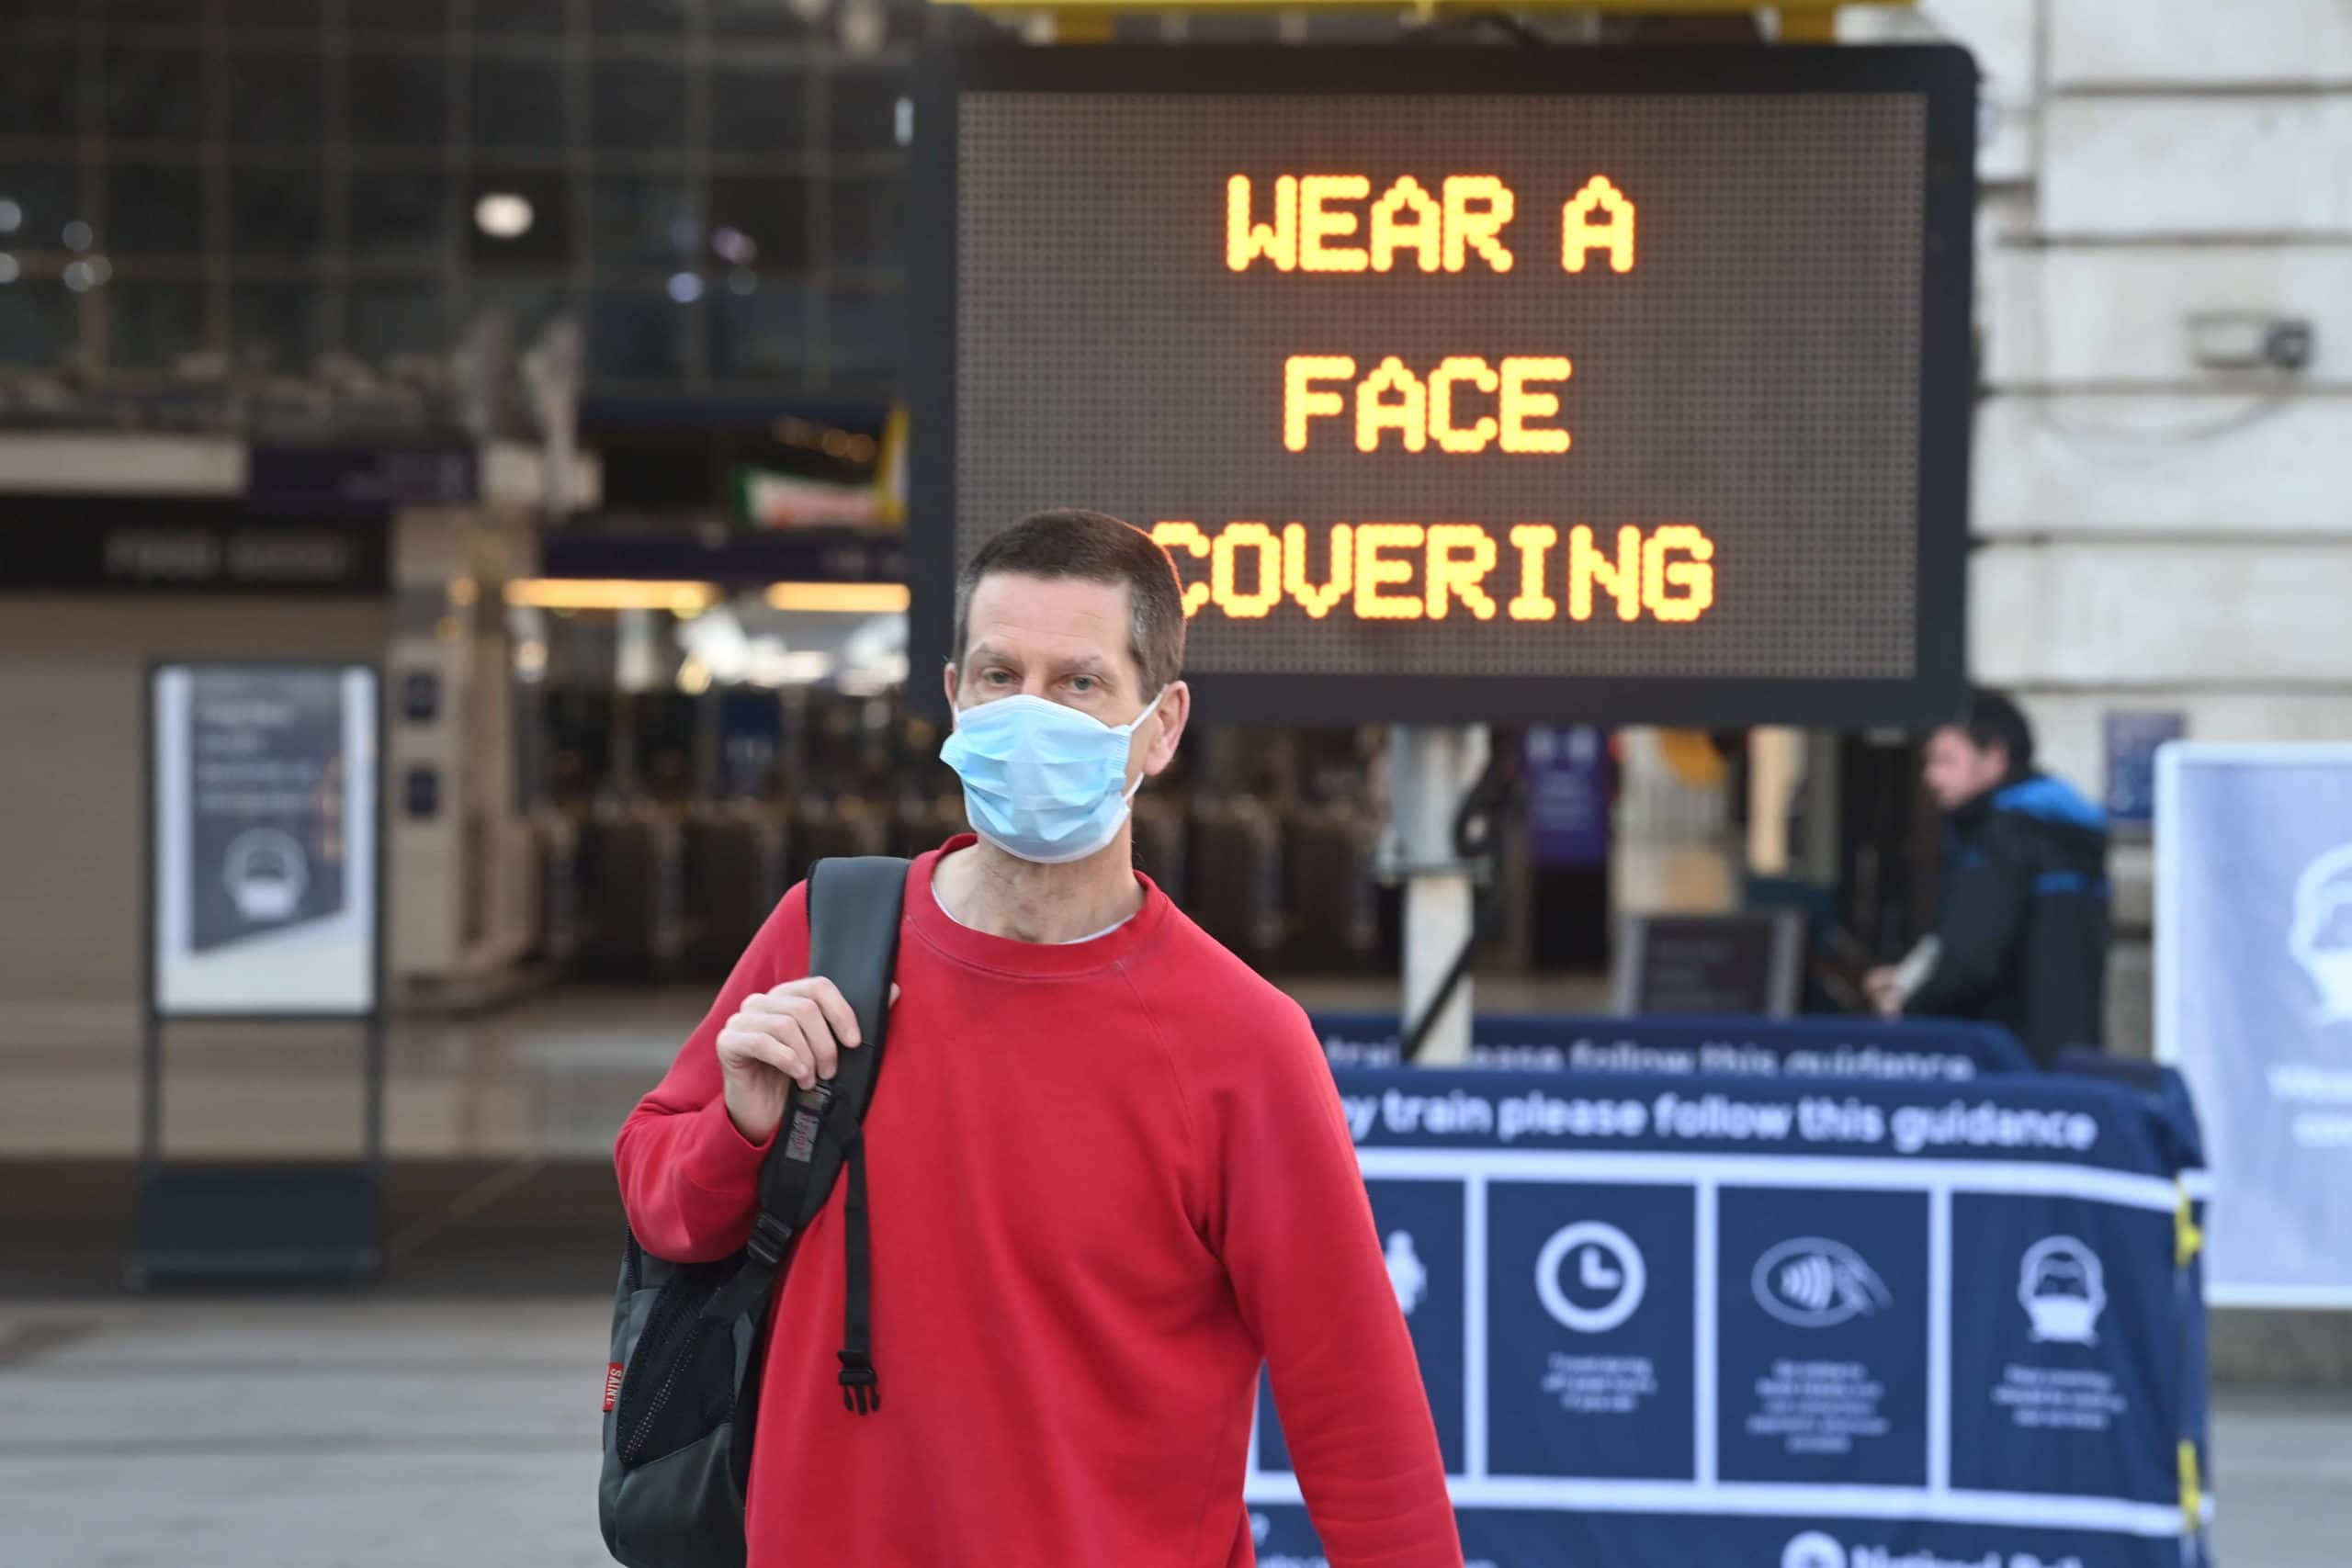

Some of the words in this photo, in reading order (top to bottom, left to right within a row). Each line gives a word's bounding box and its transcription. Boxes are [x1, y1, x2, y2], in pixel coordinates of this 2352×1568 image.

[1227, 175, 1514, 273] WEAR
[1562, 175, 1635, 274] A
[1283, 355, 1572, 454] FACE
[1151, 521, 1714, 623] COVERING
[1382, 1088, 1493, 1135] train
[1497, 1089, 1649, 1142] please
[1653, 1091, 1792, 1139] follow
[1797, 1095, 1886, 1144] this
[1890, 1099, 2099, 1155] guidance
